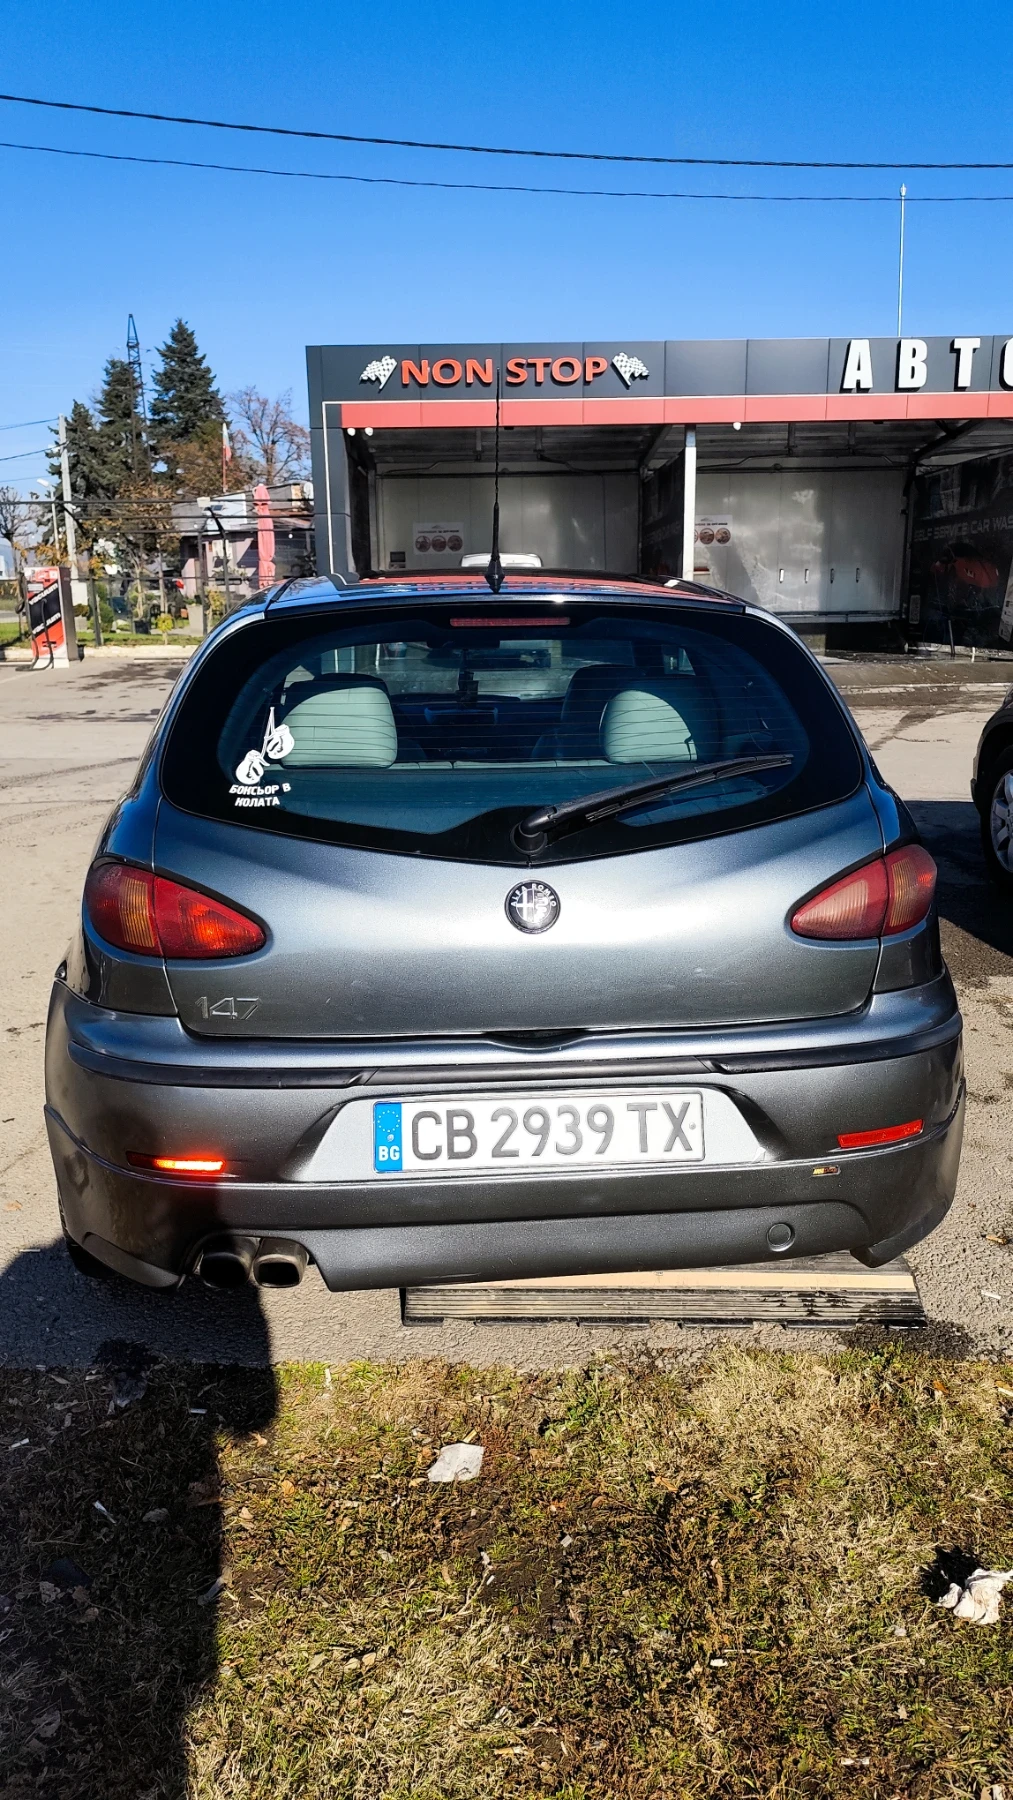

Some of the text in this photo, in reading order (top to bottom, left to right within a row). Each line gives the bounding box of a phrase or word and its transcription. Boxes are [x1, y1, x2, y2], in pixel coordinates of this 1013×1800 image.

[401, 357, 608, 385] NON STOP
[934, 522, 969, 539] SERVICE
[971, 519, 990, 535] CAR
[229, 783, 291, 795] БОКСЬОР В
[235, 797, 280, 807] КОЛАТА
[511, 883, 557, 907] ALFA ROMEO
[195, 996, 261, 1020] 147
[411, 1101, 694, 1161] CB 2939 TX
[378, 1145, 400, 1162] BG
